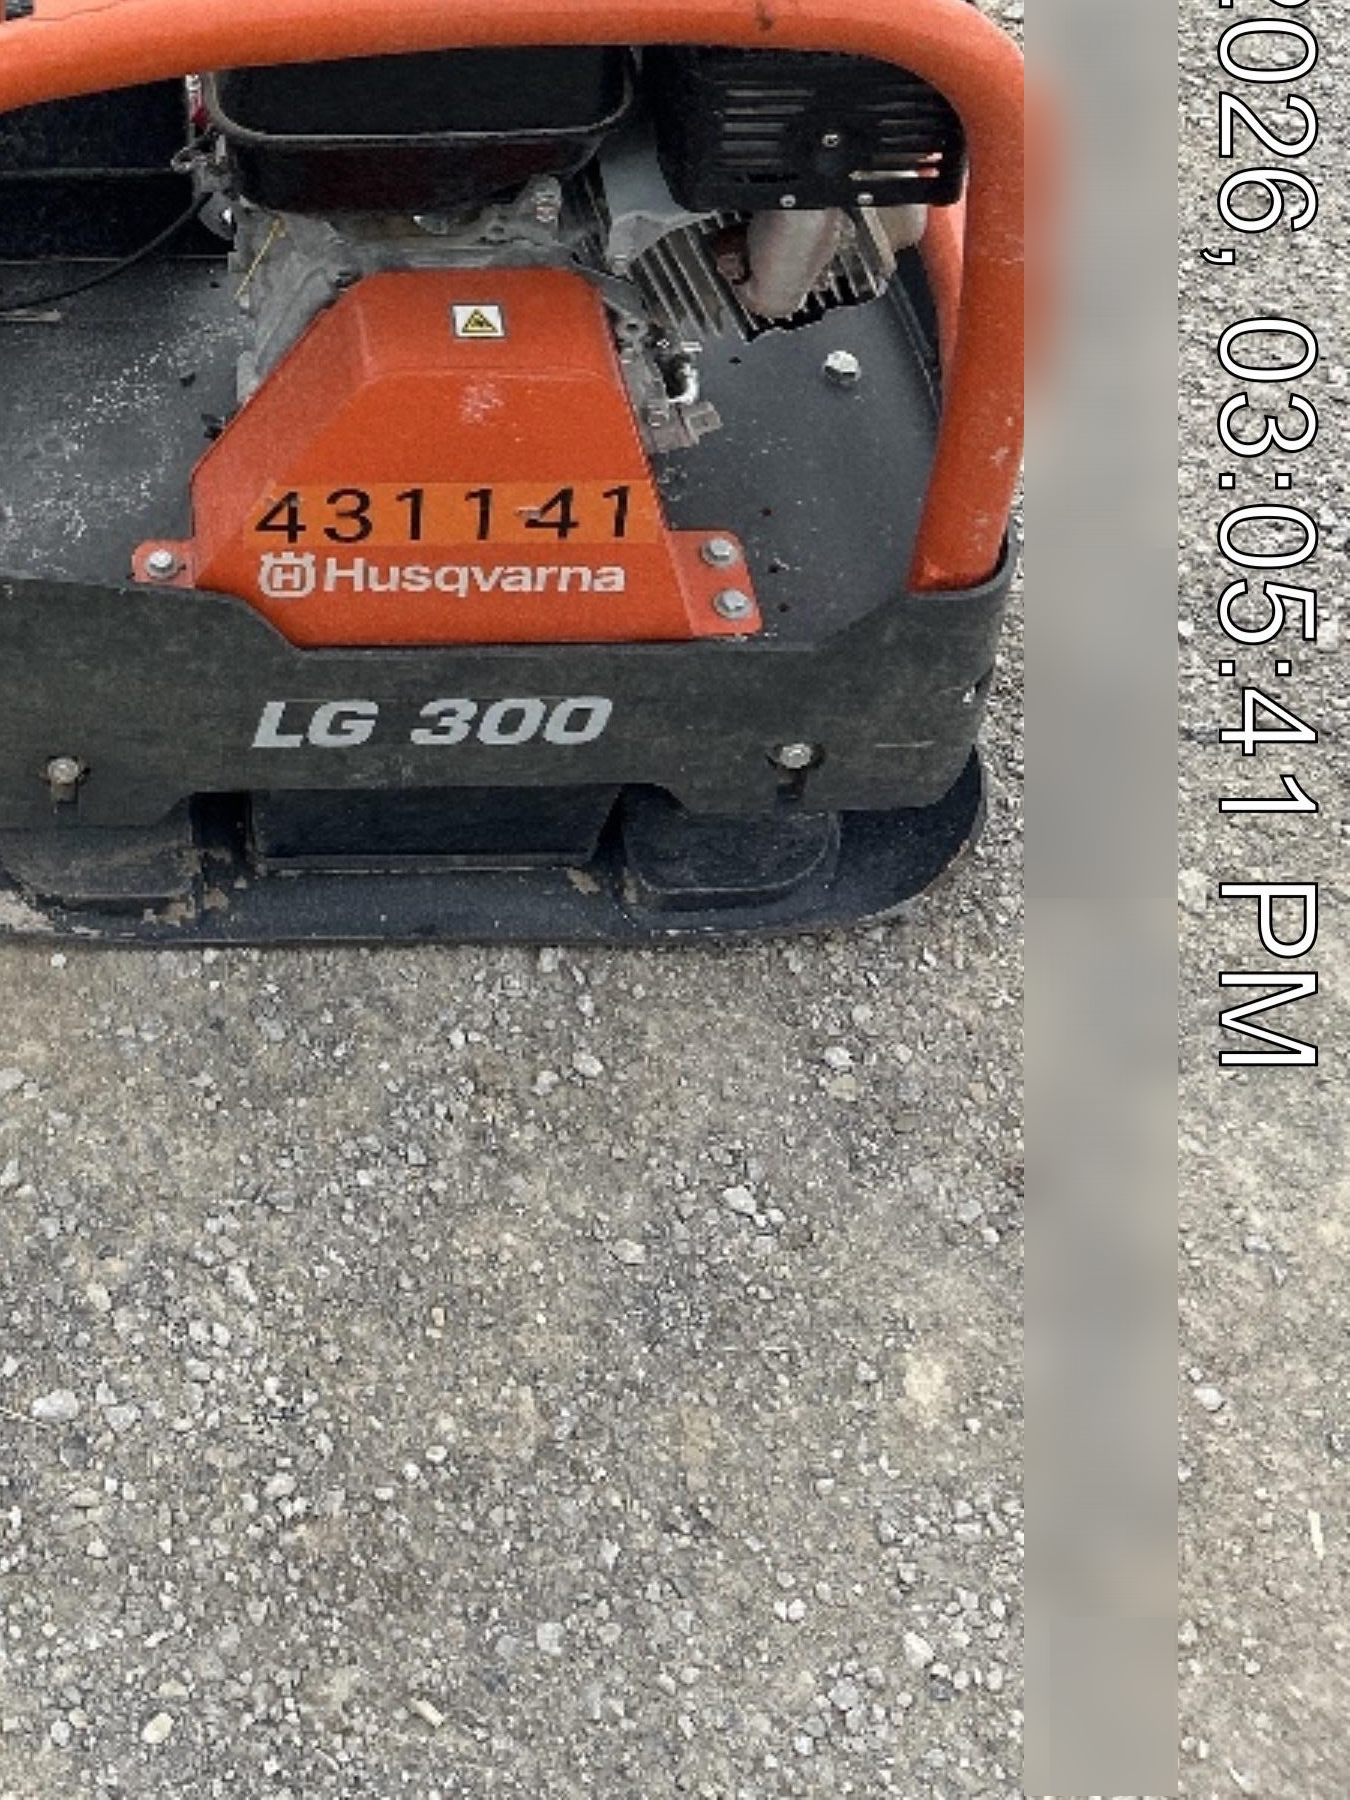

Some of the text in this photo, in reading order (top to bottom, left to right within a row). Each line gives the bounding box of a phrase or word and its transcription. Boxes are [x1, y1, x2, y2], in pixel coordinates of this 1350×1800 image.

[255, 486, 630, 543] 431141
[323, 557, 626, 598] Husqvarna
[250, 696, 613, 748] LG 300
